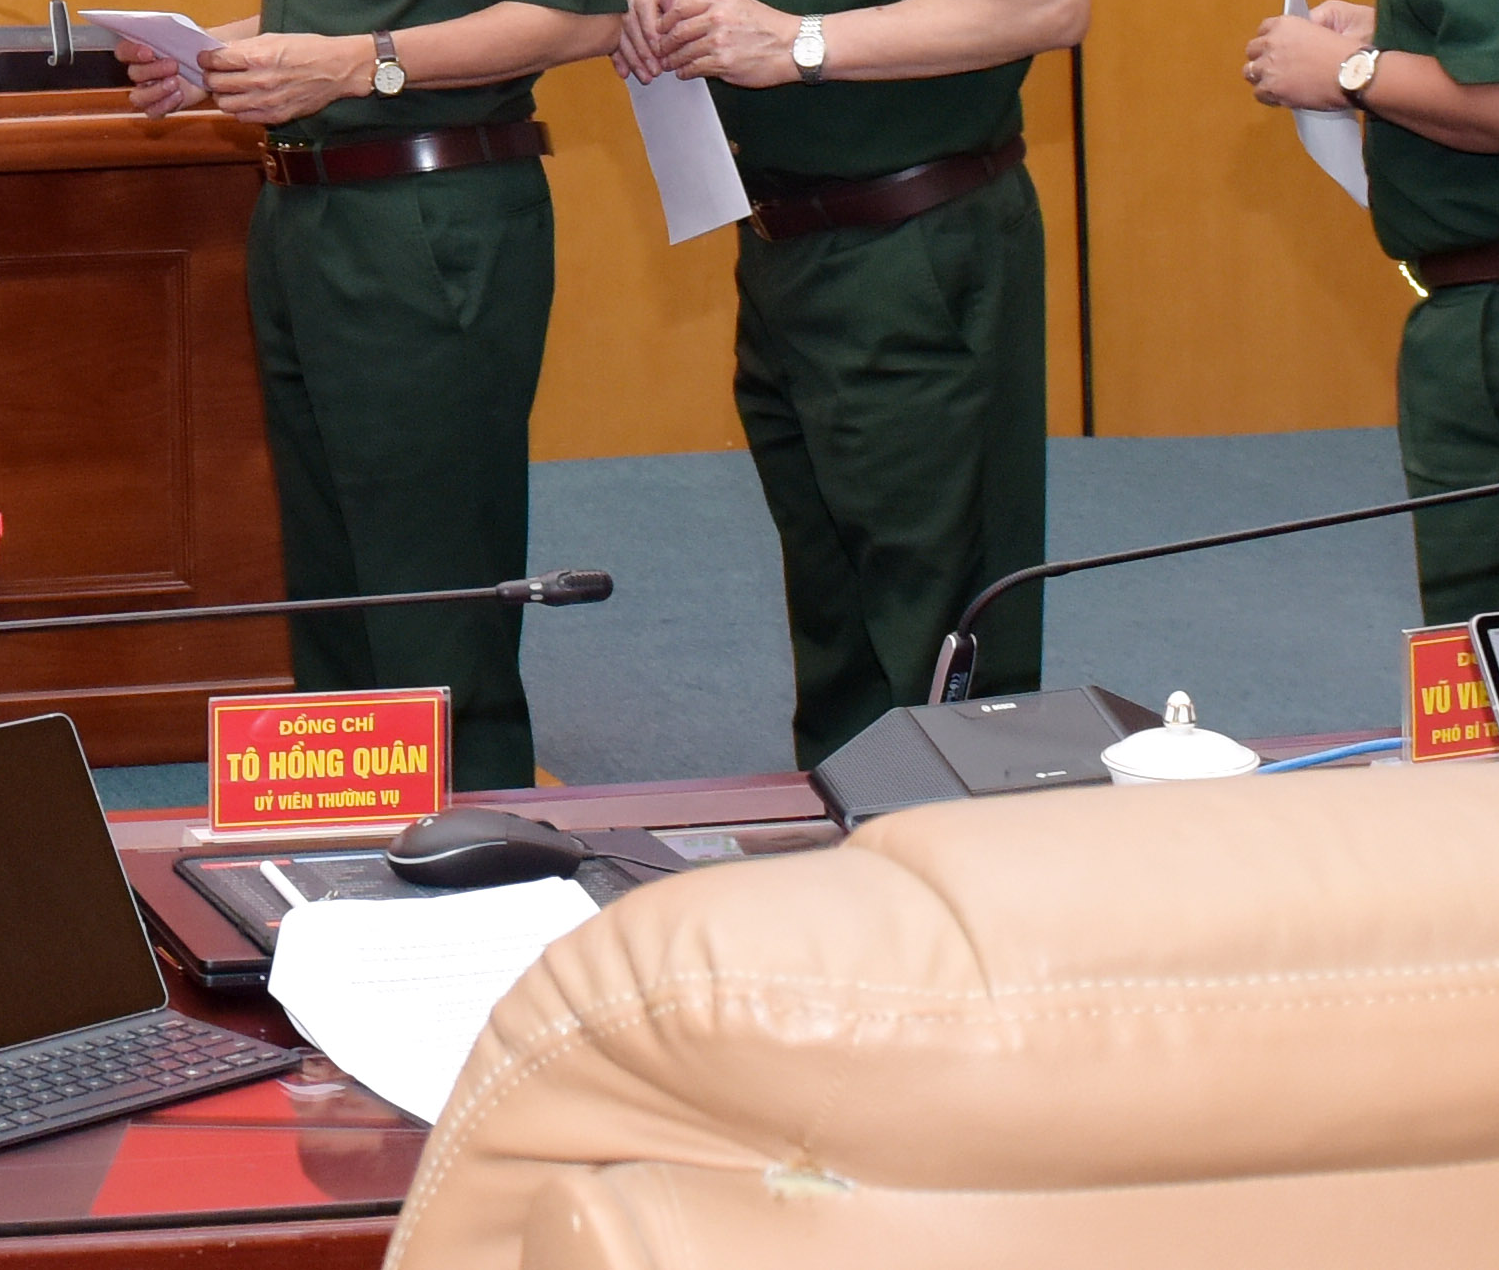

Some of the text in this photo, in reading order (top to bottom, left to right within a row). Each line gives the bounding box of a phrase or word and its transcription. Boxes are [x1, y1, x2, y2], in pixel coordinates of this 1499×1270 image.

[1422, 680, 1490, 715] VŨ VIE
[279, 713, 374, 735] ĐỒNG CHÍ
[1432, 721, 1499, 744] PHÓ BÍ TH
[227, 738, 427, 782] TÔ HỒNG QUÂN
[255, 788, 399, 811] UỶ VIÊN THƯỜNG VỤ
